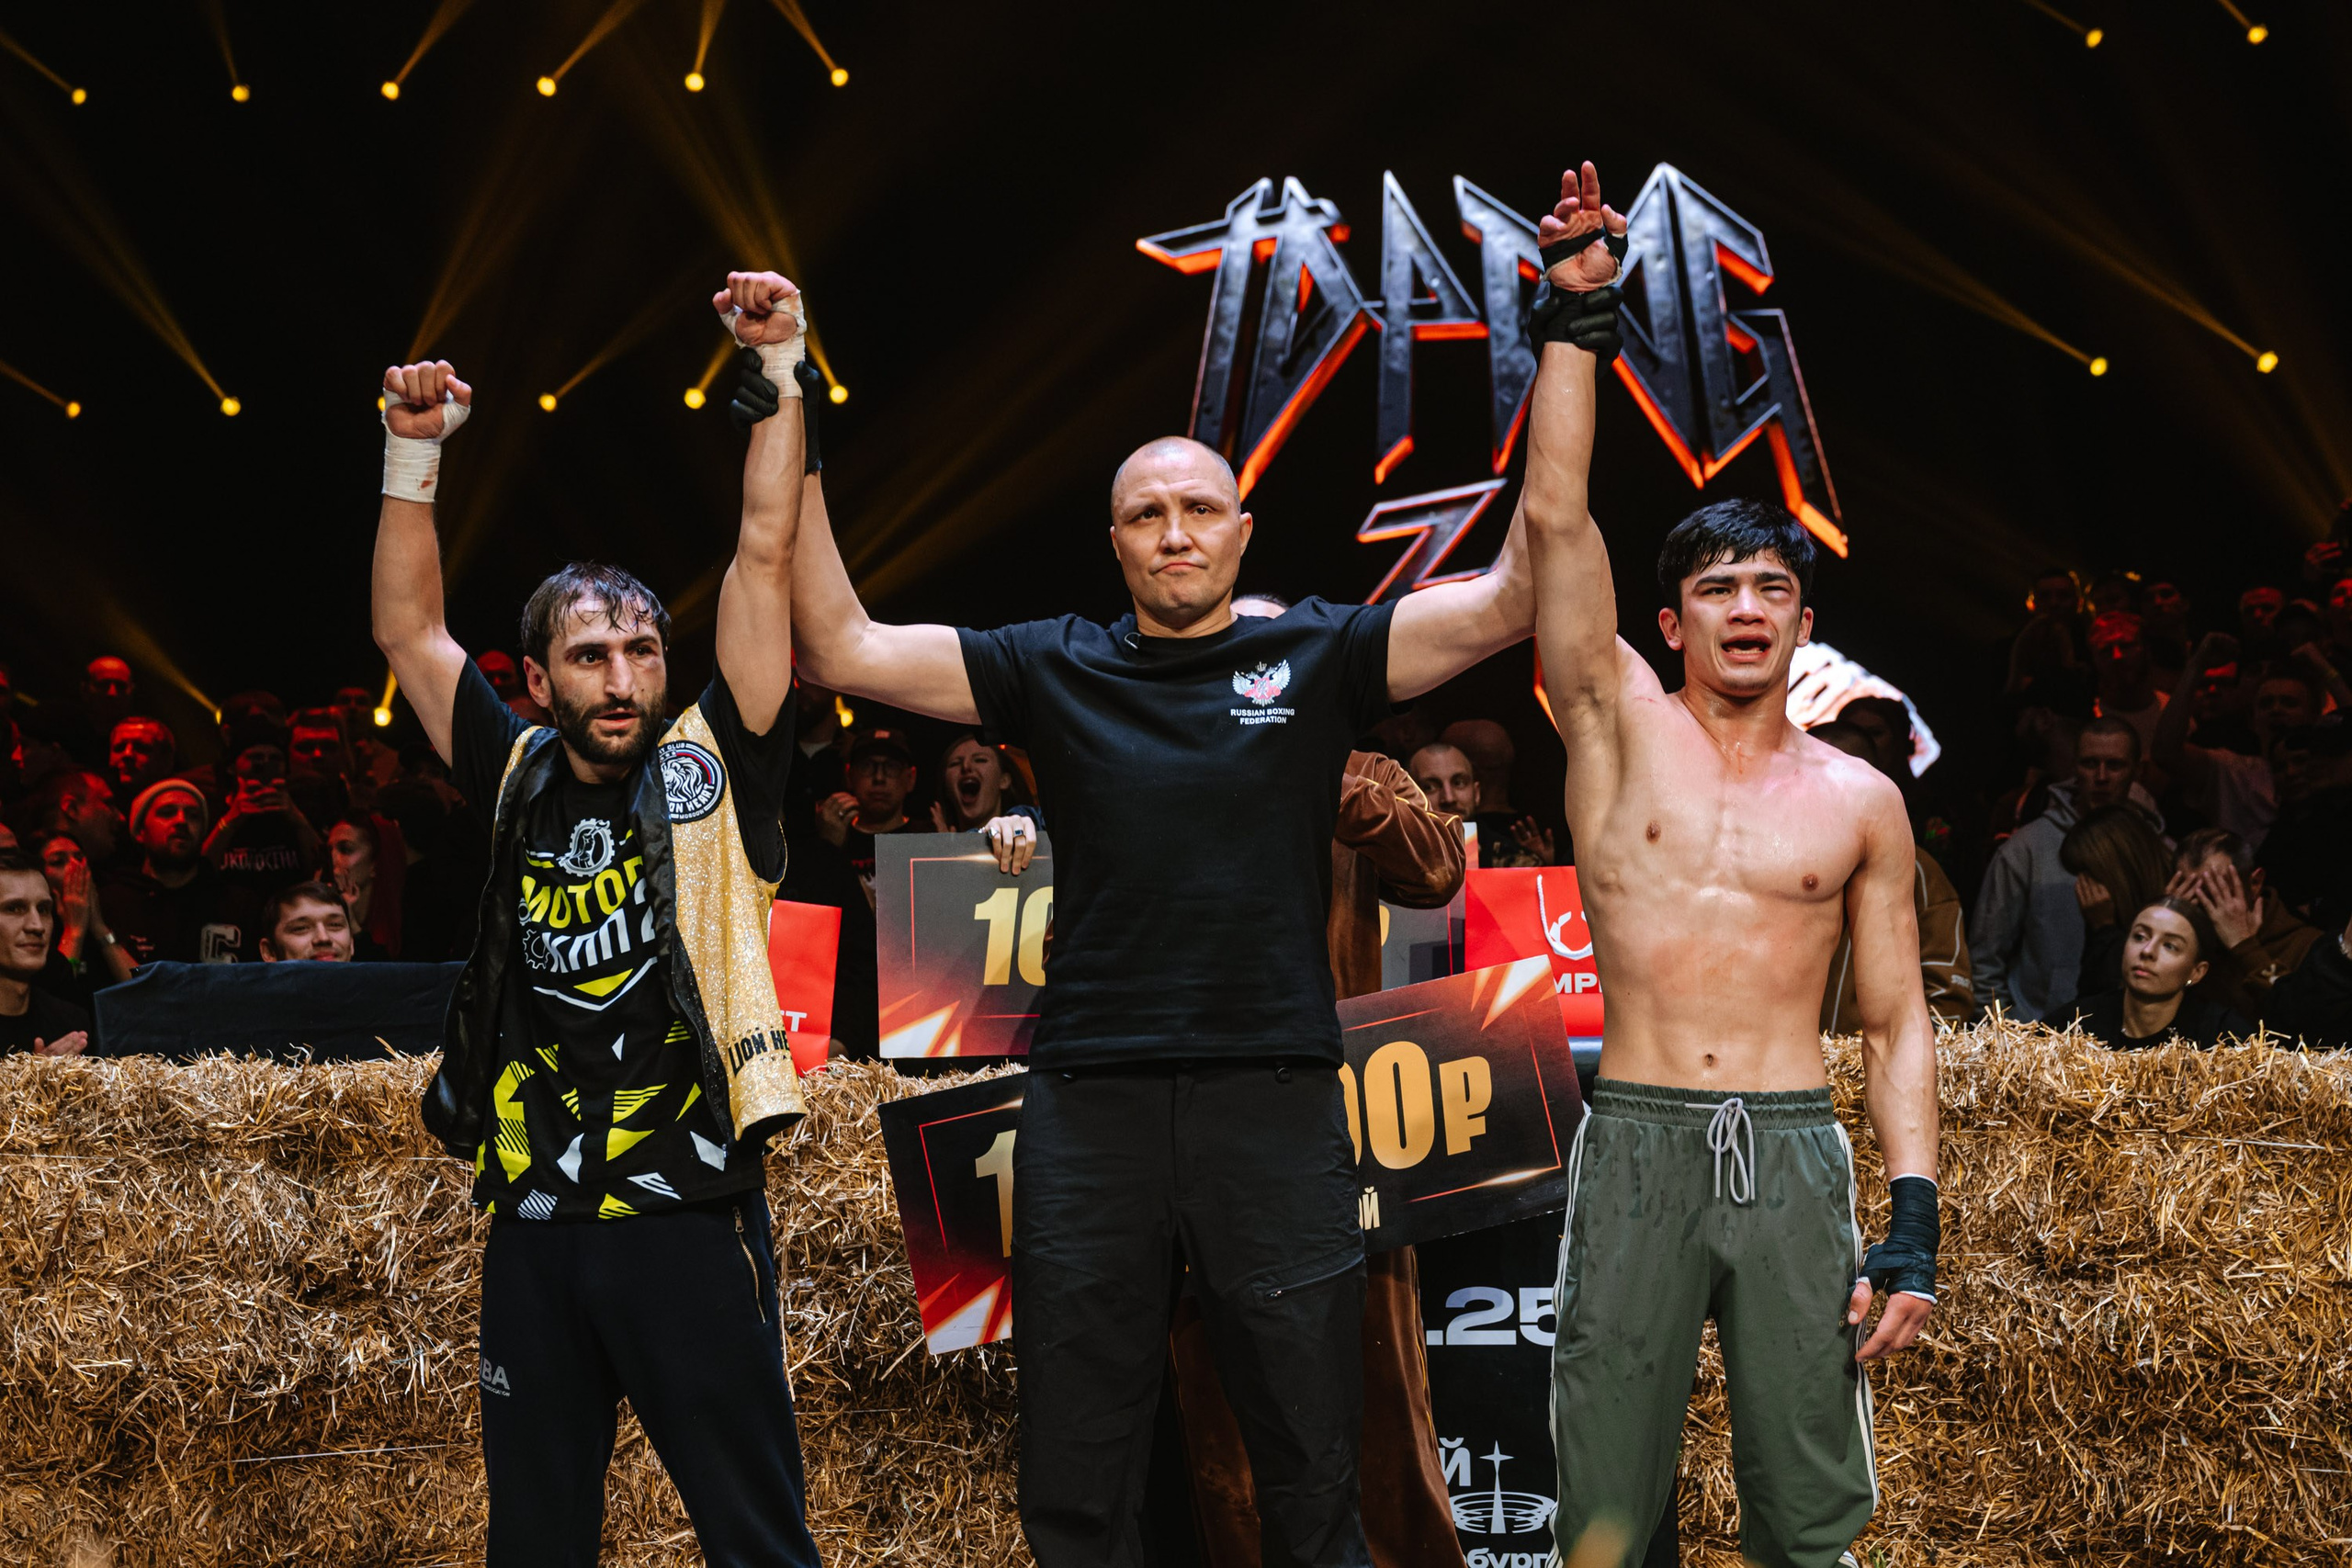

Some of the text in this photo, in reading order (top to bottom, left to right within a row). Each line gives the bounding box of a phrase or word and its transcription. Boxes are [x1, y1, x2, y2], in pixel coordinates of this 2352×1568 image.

[1239, 716, 1287, 725] FEDERATION
[666, 742, 685, 750] CLUB
[685, 783, 715, 812] HEART
[679, 808, 706, 819] MOSCOW
[1554, 973, 1603, 994] MP
[728, 1032, 768, 1077] LION
[1358, 1186, 1381, 1231] Й
[1464, 1547, 1549, 1568] бург
